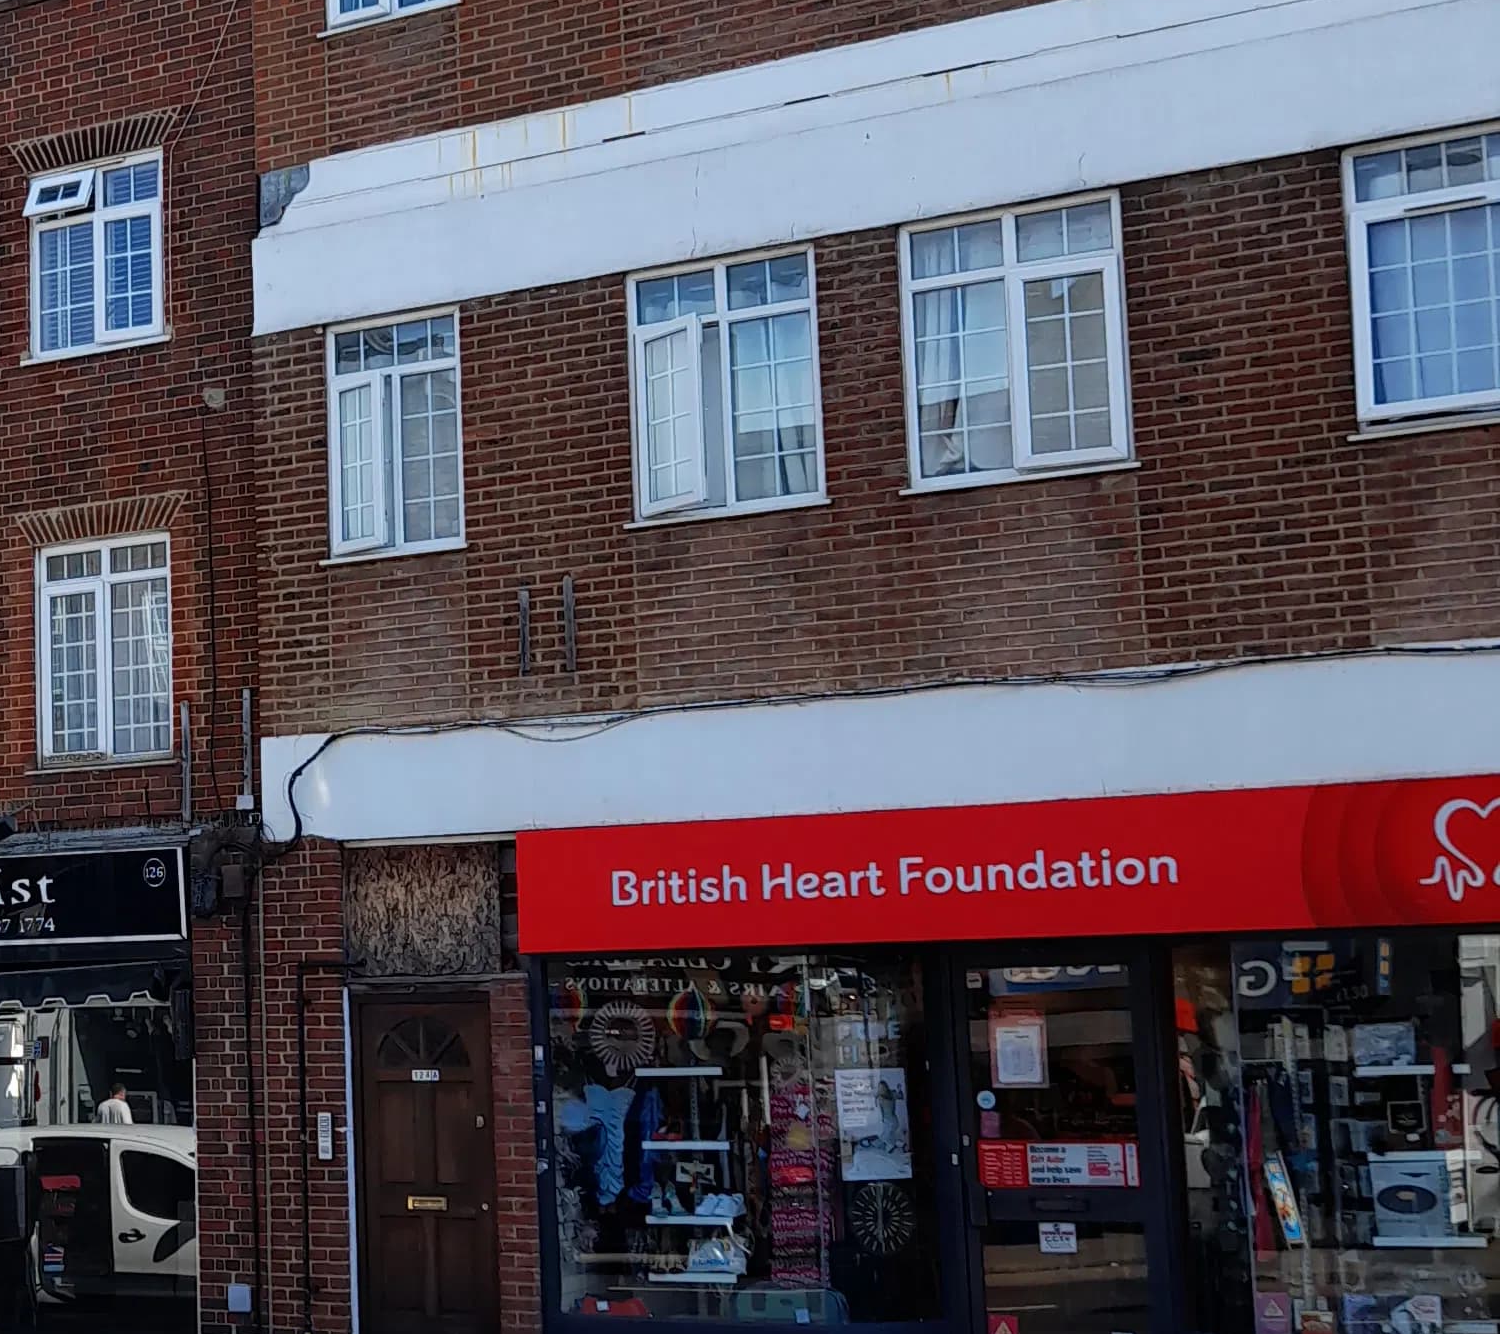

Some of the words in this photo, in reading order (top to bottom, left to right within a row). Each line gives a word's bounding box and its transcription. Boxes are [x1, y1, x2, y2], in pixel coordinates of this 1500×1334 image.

[145, 866, 164, 878] 126
[610, 864, 749, 907] British
[760, 861, 886, 900] Heart
[898, 849, 1179, 895] Foundation
[19, 917, 56, 933] 1774
